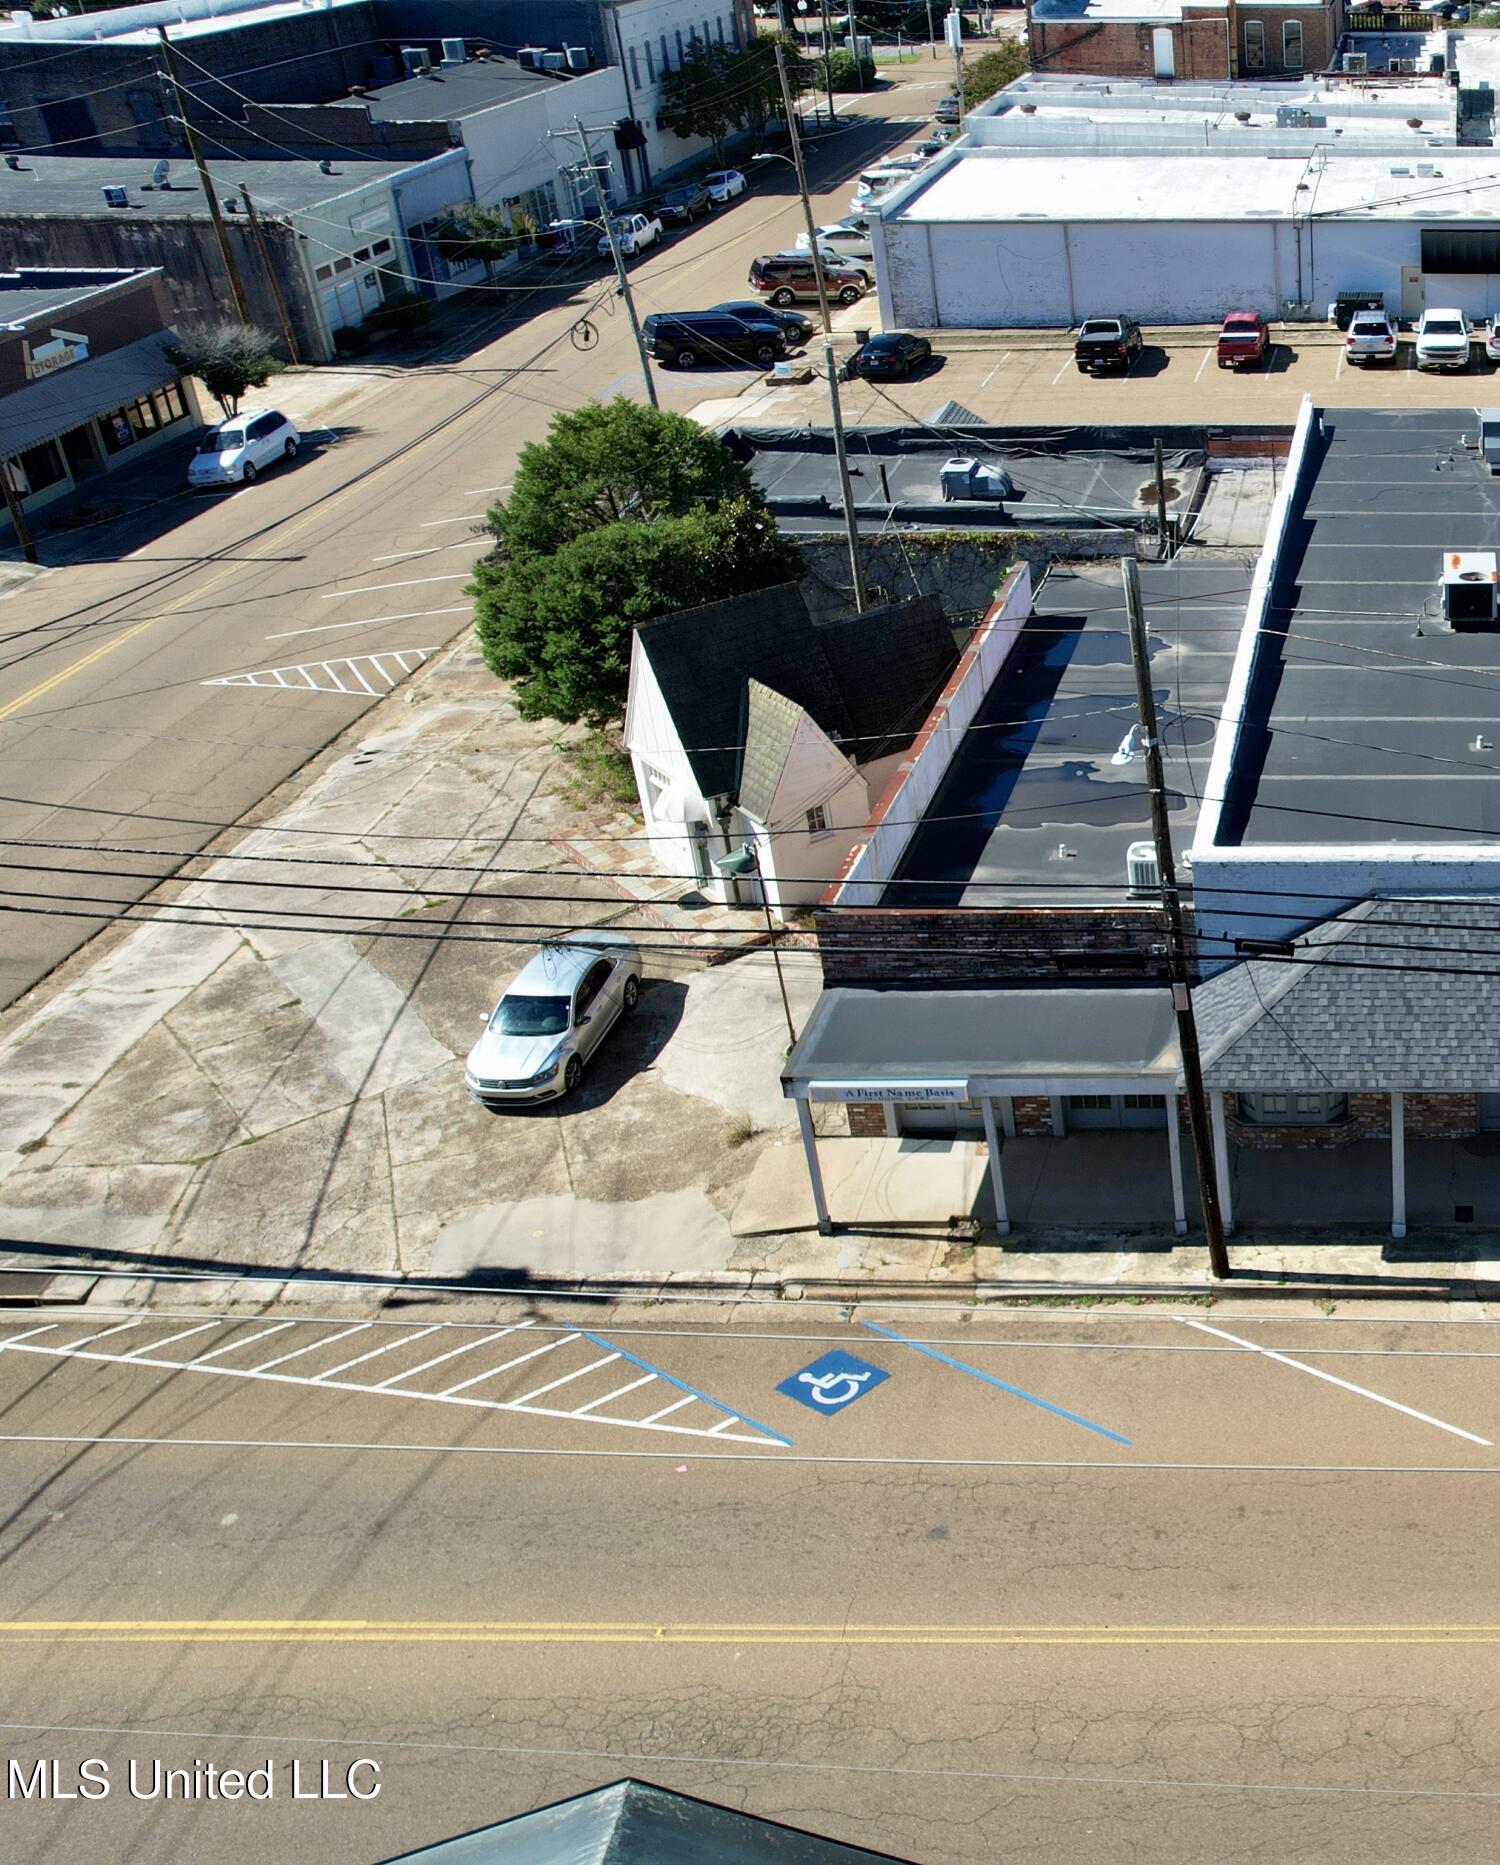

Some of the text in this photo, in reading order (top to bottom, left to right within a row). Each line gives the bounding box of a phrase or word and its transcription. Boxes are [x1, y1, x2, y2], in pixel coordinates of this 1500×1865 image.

[33, 348, 76, 374] STORAGE
[846, 1088, 955, 1097] A First Name Basis
